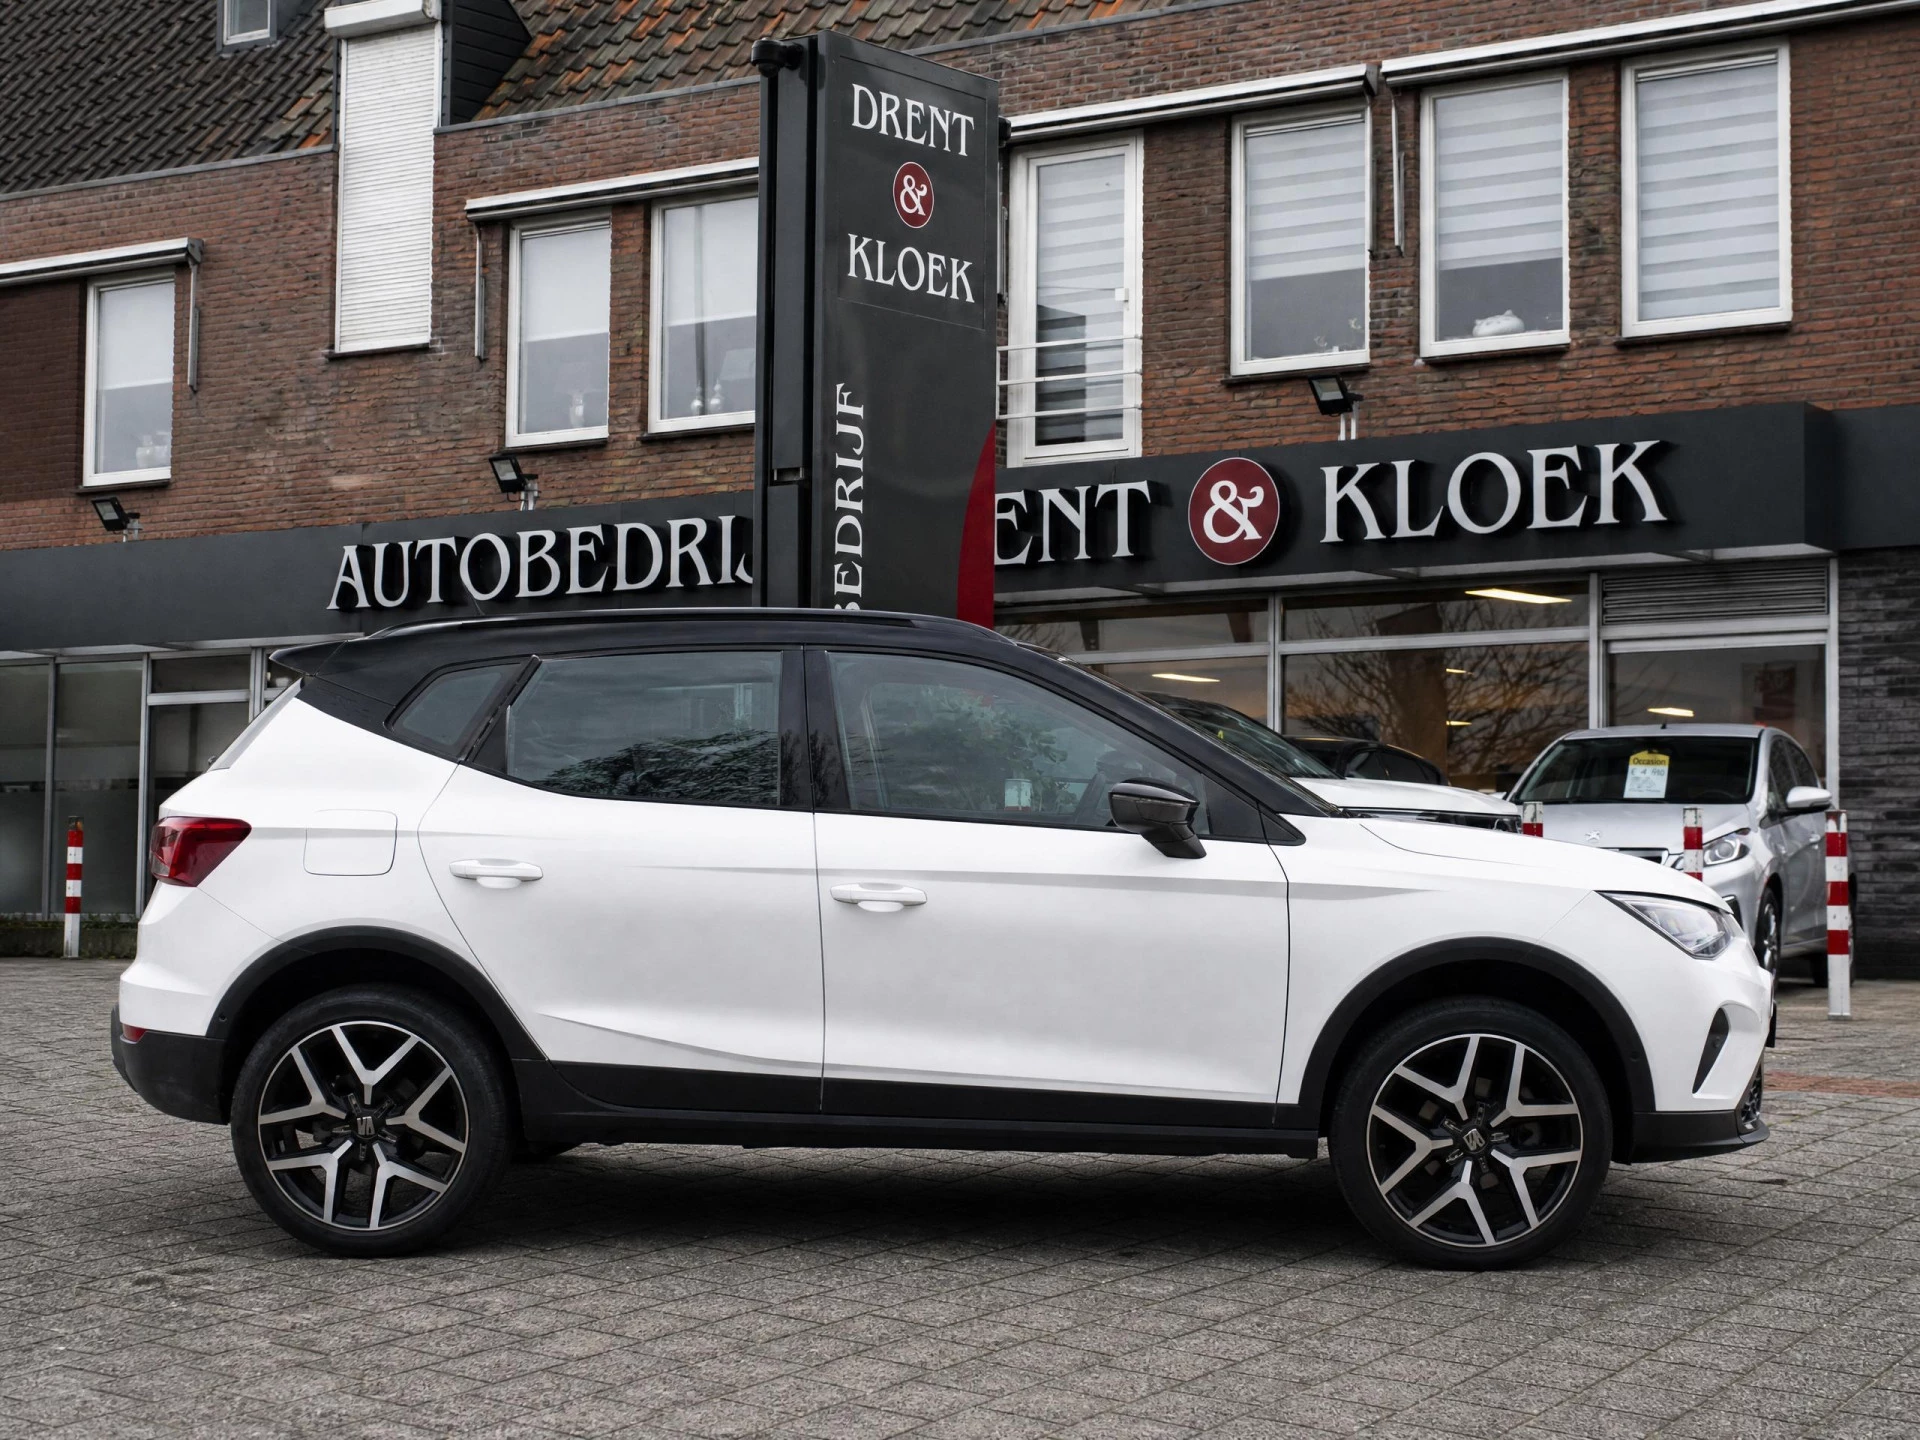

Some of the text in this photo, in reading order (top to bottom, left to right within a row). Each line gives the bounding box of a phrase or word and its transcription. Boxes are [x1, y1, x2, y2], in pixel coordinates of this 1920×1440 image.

[852, 83, 975, 157] DRENT
[899, 174, 928, 217] &
[847, 233, 976, 304] KLOEK
[834, 382, 865, 610] EDRIJF
[1202, 479, 1264, 544] &
[1319, 440, 1668, 543] KLOEK
